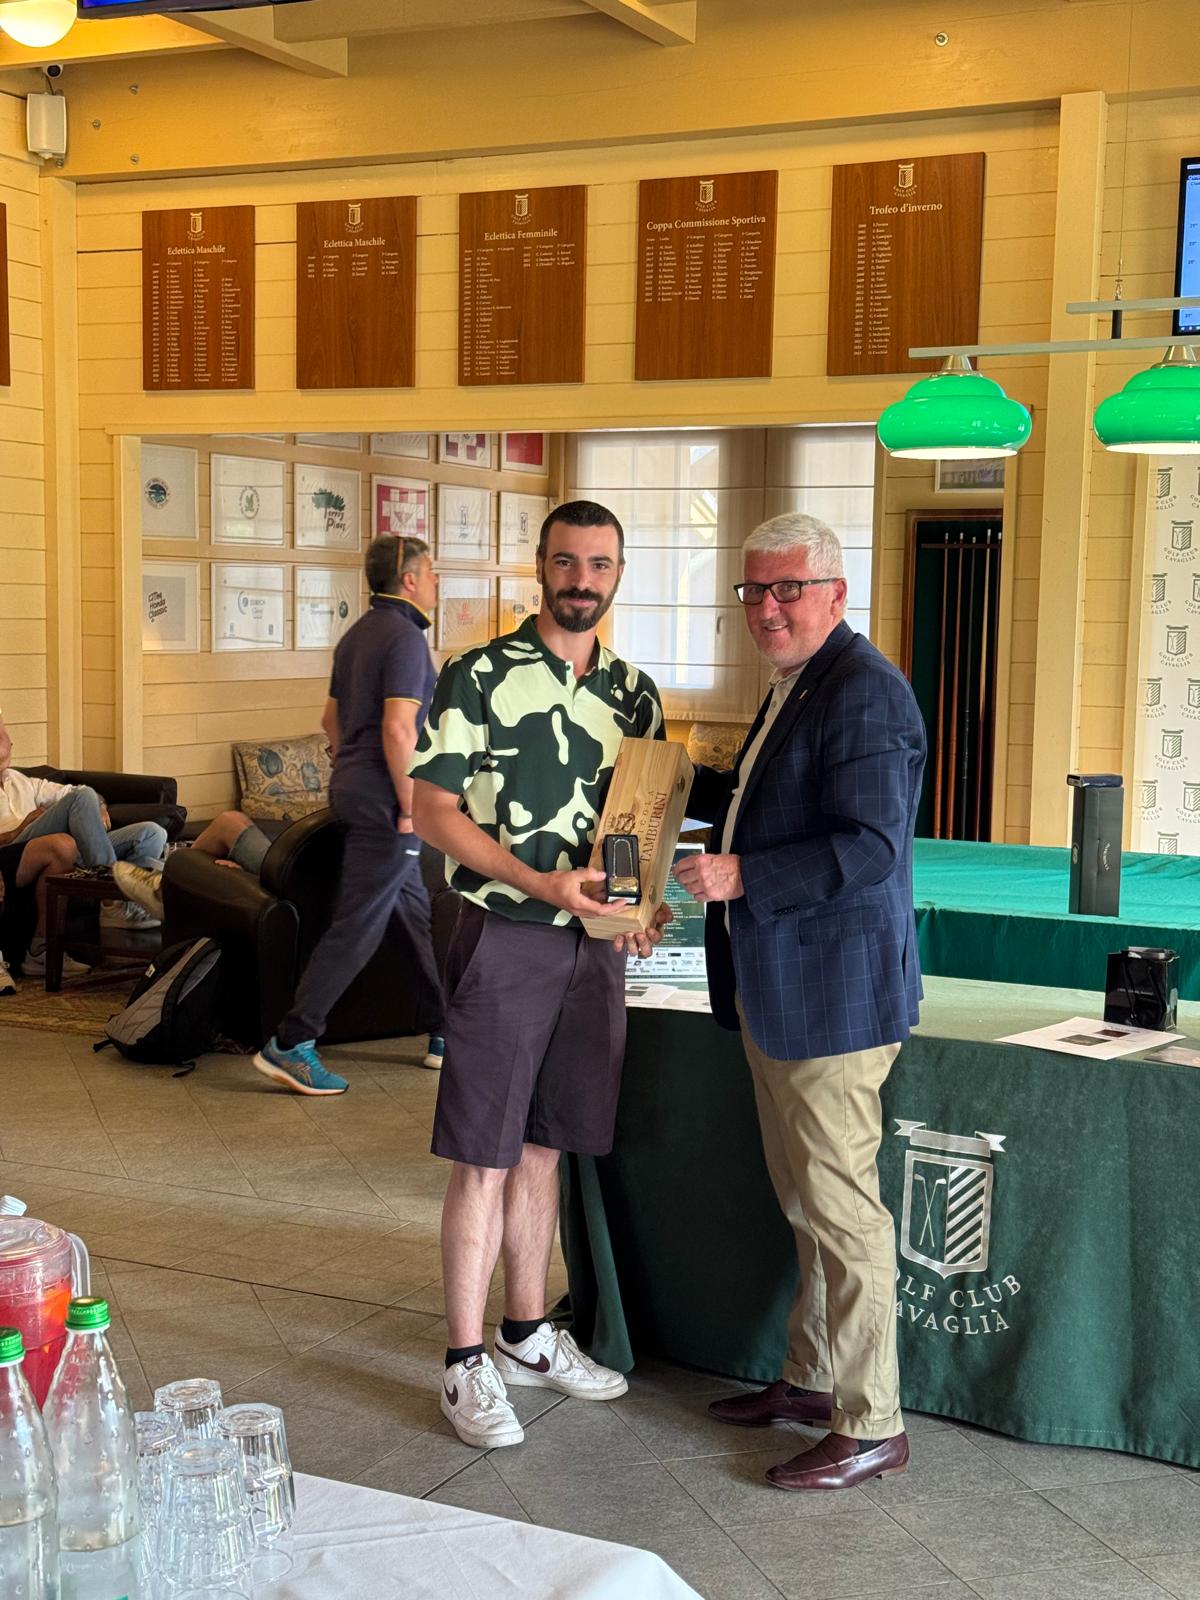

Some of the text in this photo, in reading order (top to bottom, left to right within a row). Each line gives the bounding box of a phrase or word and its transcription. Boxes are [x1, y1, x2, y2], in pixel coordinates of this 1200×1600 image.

[870, 202, 942, 215] Trofeo d'inverno
[646, 214, 766, 232] Coppa Commissione Sportiva
[484, 228, 558, 241] Eclettica Femminile
[167, 244, 226, 255] Eclettica Maschile
[324, 237, 386, 248] Eclettica Maschile
[640, 792, 667, 864] TAMBURINI
[896, 1266, 1022, 1308] LF CLUB
[896, 1300, 1010, 1335] AVAGLIÀ
